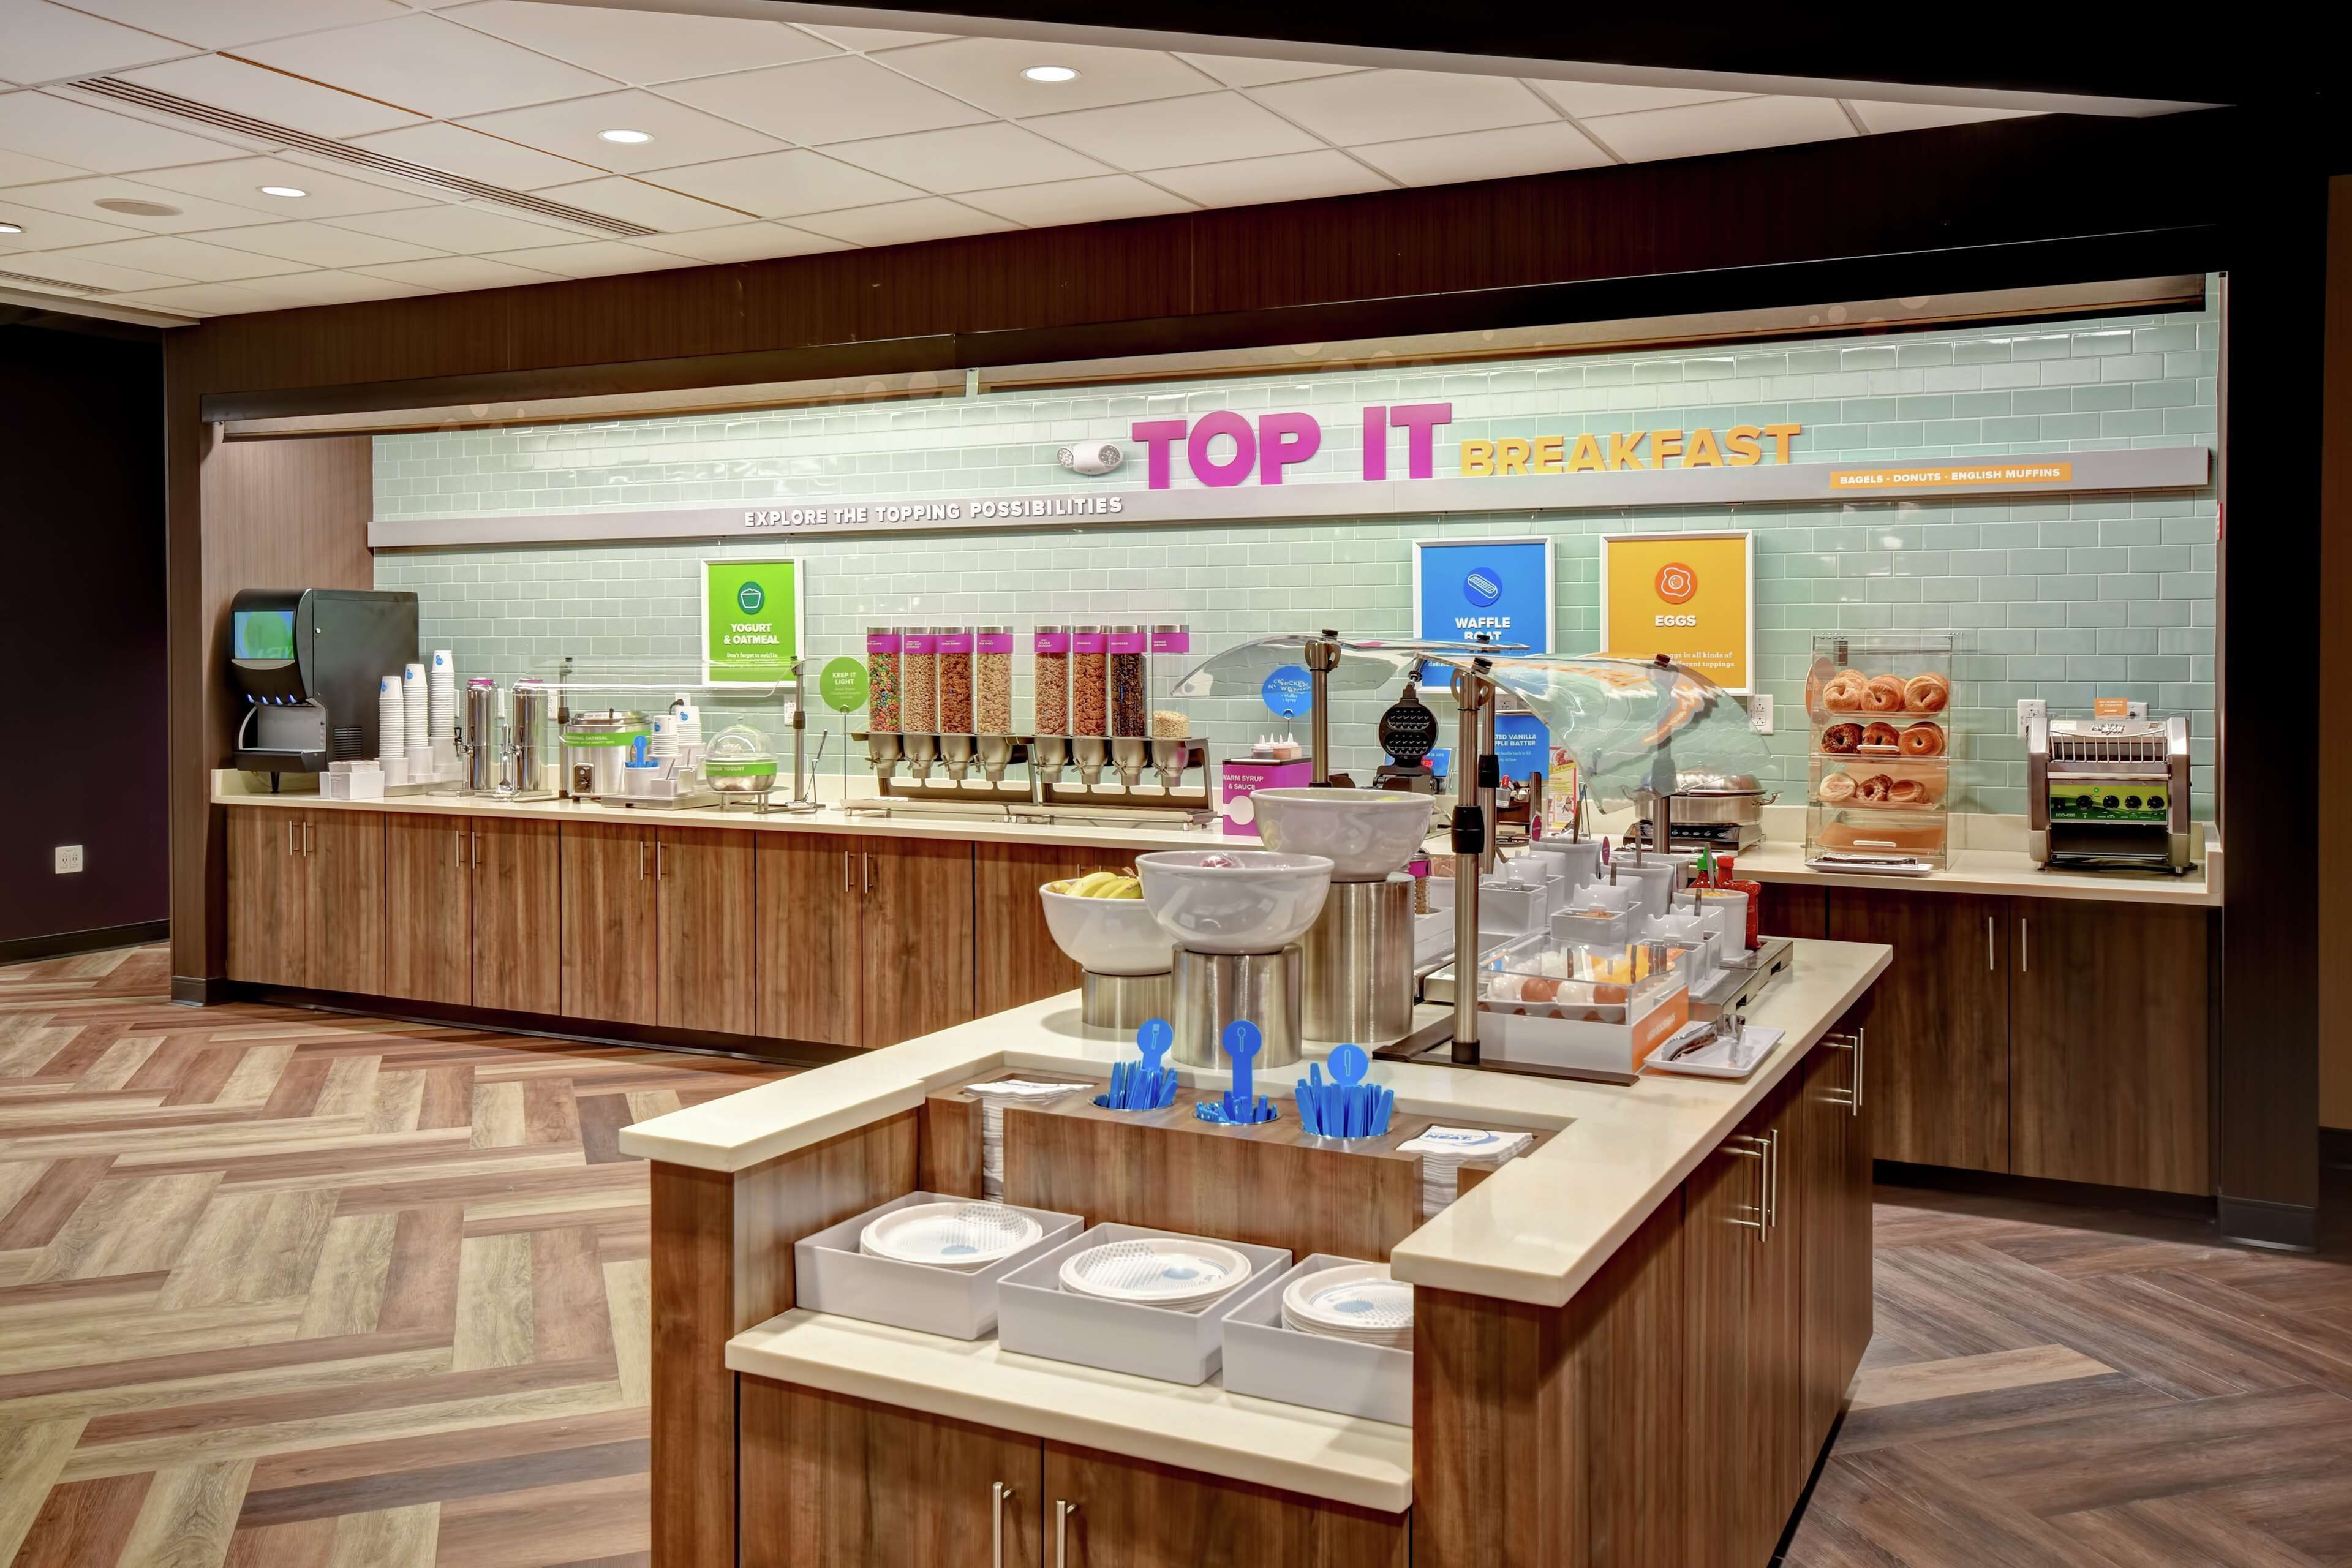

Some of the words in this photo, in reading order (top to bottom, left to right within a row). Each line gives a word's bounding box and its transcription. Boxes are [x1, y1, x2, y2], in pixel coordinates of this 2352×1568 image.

[1132, 410, 1321, 490] TOP
[1363, 402, 1452, 481] IT
[1460, 423, 1802, 477] BREAKFAST
[1840, 474, 1883, 484] BAGELS
[1893, 473, 1941, 483] DONUTS
[1951, 470, 2002, 481] ENGLISH
[2005, 468, 2060, 479] MUFFINS
[744, 508, 827, 527] EXPLORE
[833, 507, 868, 524] THE
[875, 503, 960, 522] TOPPING
[970, 496, 1123, 518] POSSIBILITIES
[1455, 617, 1511, 629] WAFFLE
[1654, 614, 1697, 627] EGGS
[729, 623, 773, 633] YOGURT
[723, 635, 731, 644] &
[733, 635, 780, 644] OATMEAL
